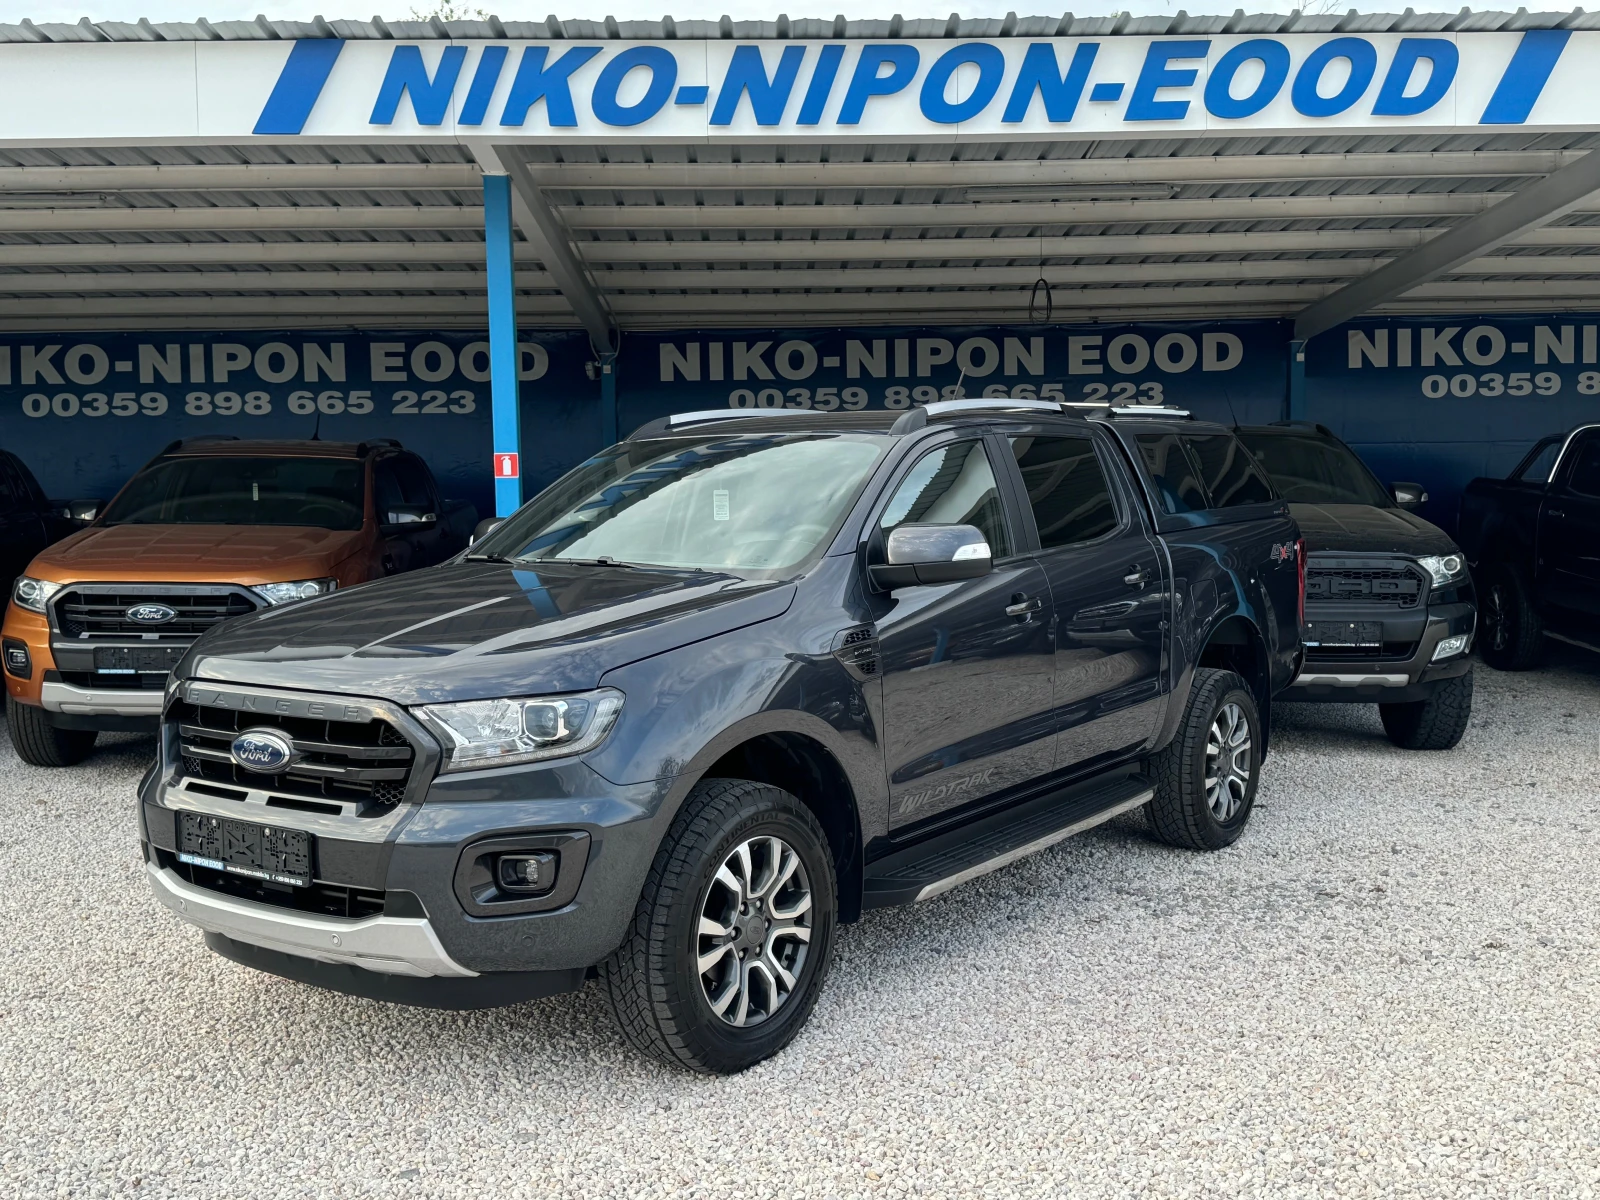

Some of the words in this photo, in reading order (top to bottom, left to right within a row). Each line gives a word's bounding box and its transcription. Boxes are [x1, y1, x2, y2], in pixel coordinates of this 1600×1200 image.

[369, 37, 1459, 127] NIKO-NIPON-EOOD
[370, 341, 549, 383] EOOD
[659, 337, 1045, 382] NIKO-NIPON
[1068, 333, 1244, 375] EOOD
[728, 387, 869, 411] 00359
[884, 385, 966, 410] 898
[982, 383, 1065, 403] 665
[1082, 382, 1164, 405] 223
[1421, 372, 1562, 398] 00359
[22, 391, 169, 417] 00359
[185, 390, 272, 416] 898
[287, 390, 374, 414] 665
[391, 390, 476, 414] 223
[82, 586, 224, 594] RANGER
[137, 607, 163, 619] Ford
[187, 688, 361, 720] RANGER
[240, 739, 272, 763] Ford
[899, 768, 994, 814] WILDTRAK
[703, 811, 781, 880] CONTINENTAL
